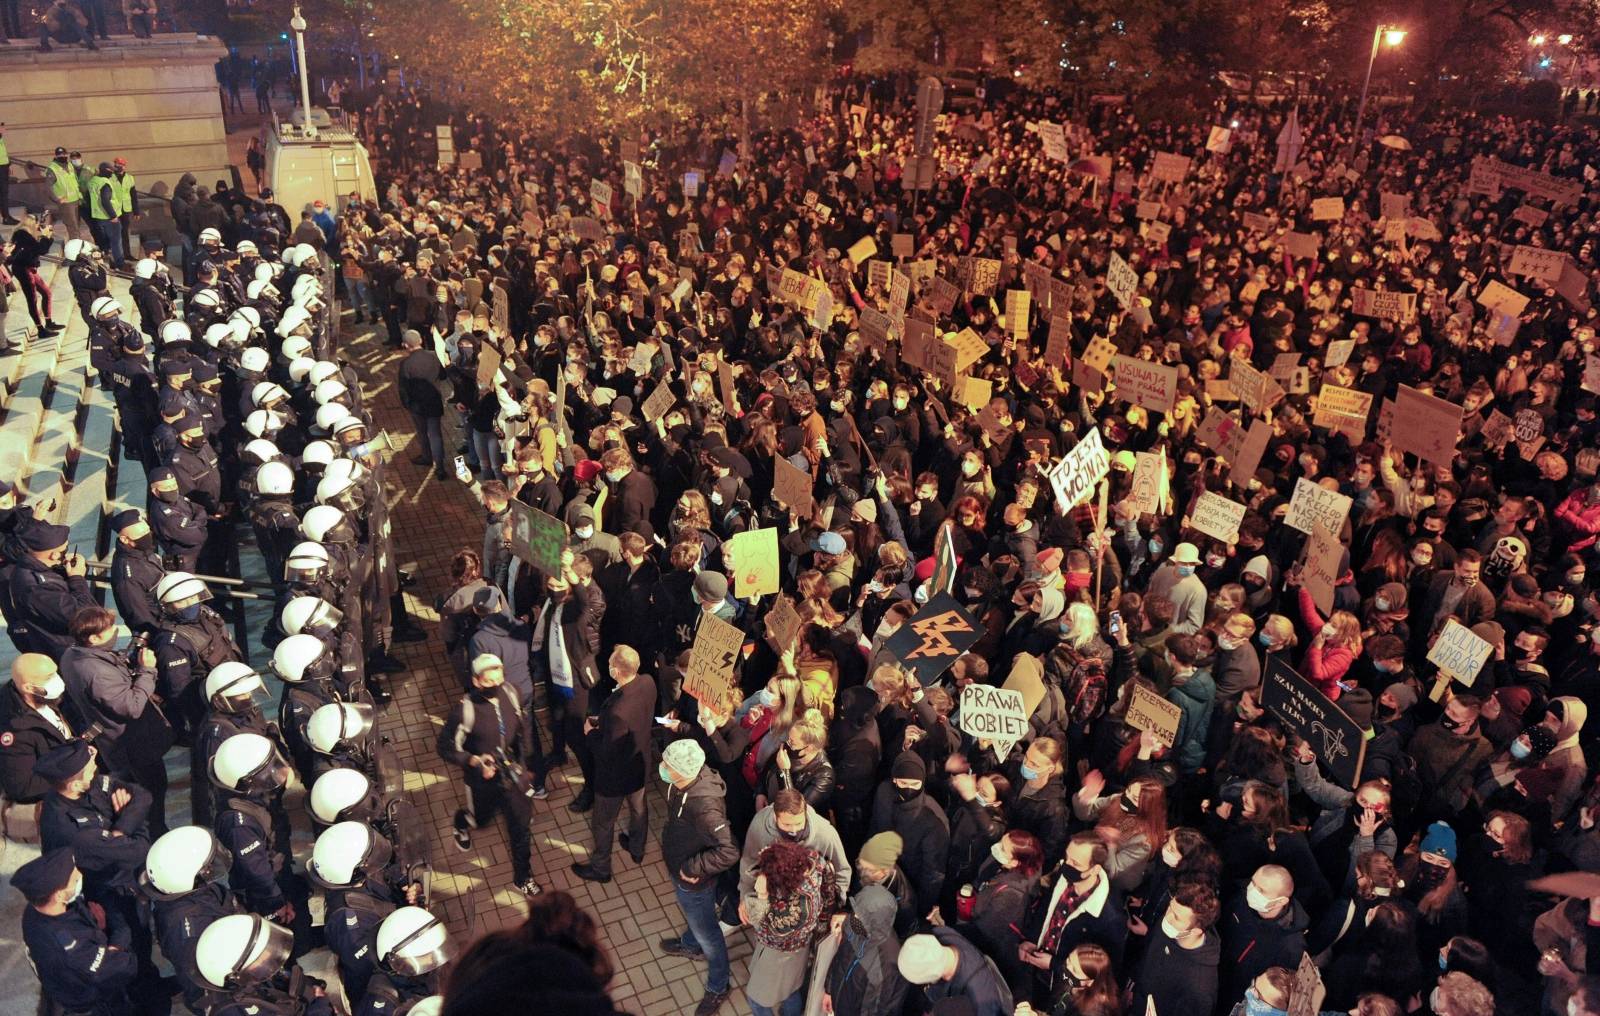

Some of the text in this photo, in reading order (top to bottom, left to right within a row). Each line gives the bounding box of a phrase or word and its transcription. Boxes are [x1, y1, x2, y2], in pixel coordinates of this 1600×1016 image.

[1117, 375, 1133, 386] NAM
[1136, 381, 1166, 397] PRAWA
[1119, 362, 1167, 386] USUWAJĄ
[1325, 387, 1350, 396] RESPECT
[1053, 436, 1097, 485] TO JEST
[1063, 453, 1106, 504] WOJNA
[1330, 509, 1342, 519] OD
[695, 635, 722, 665] TERAZ
[1442, 627, 1488, 659] WOLNY
[689, 653, 709, 677] JEST
[1434, 644, 1480, 680] WYBÓR
[690, 675, 722, 706] WOJNA
[963, 686, 1023, 714] PRAWA
[1290, 696, 1302, 711] NA
[1282, 703, 1307, 726] ULICY
[1296, 690, 1326, 720] MACICY
[962, 711, 1026, 736] KOBIET
